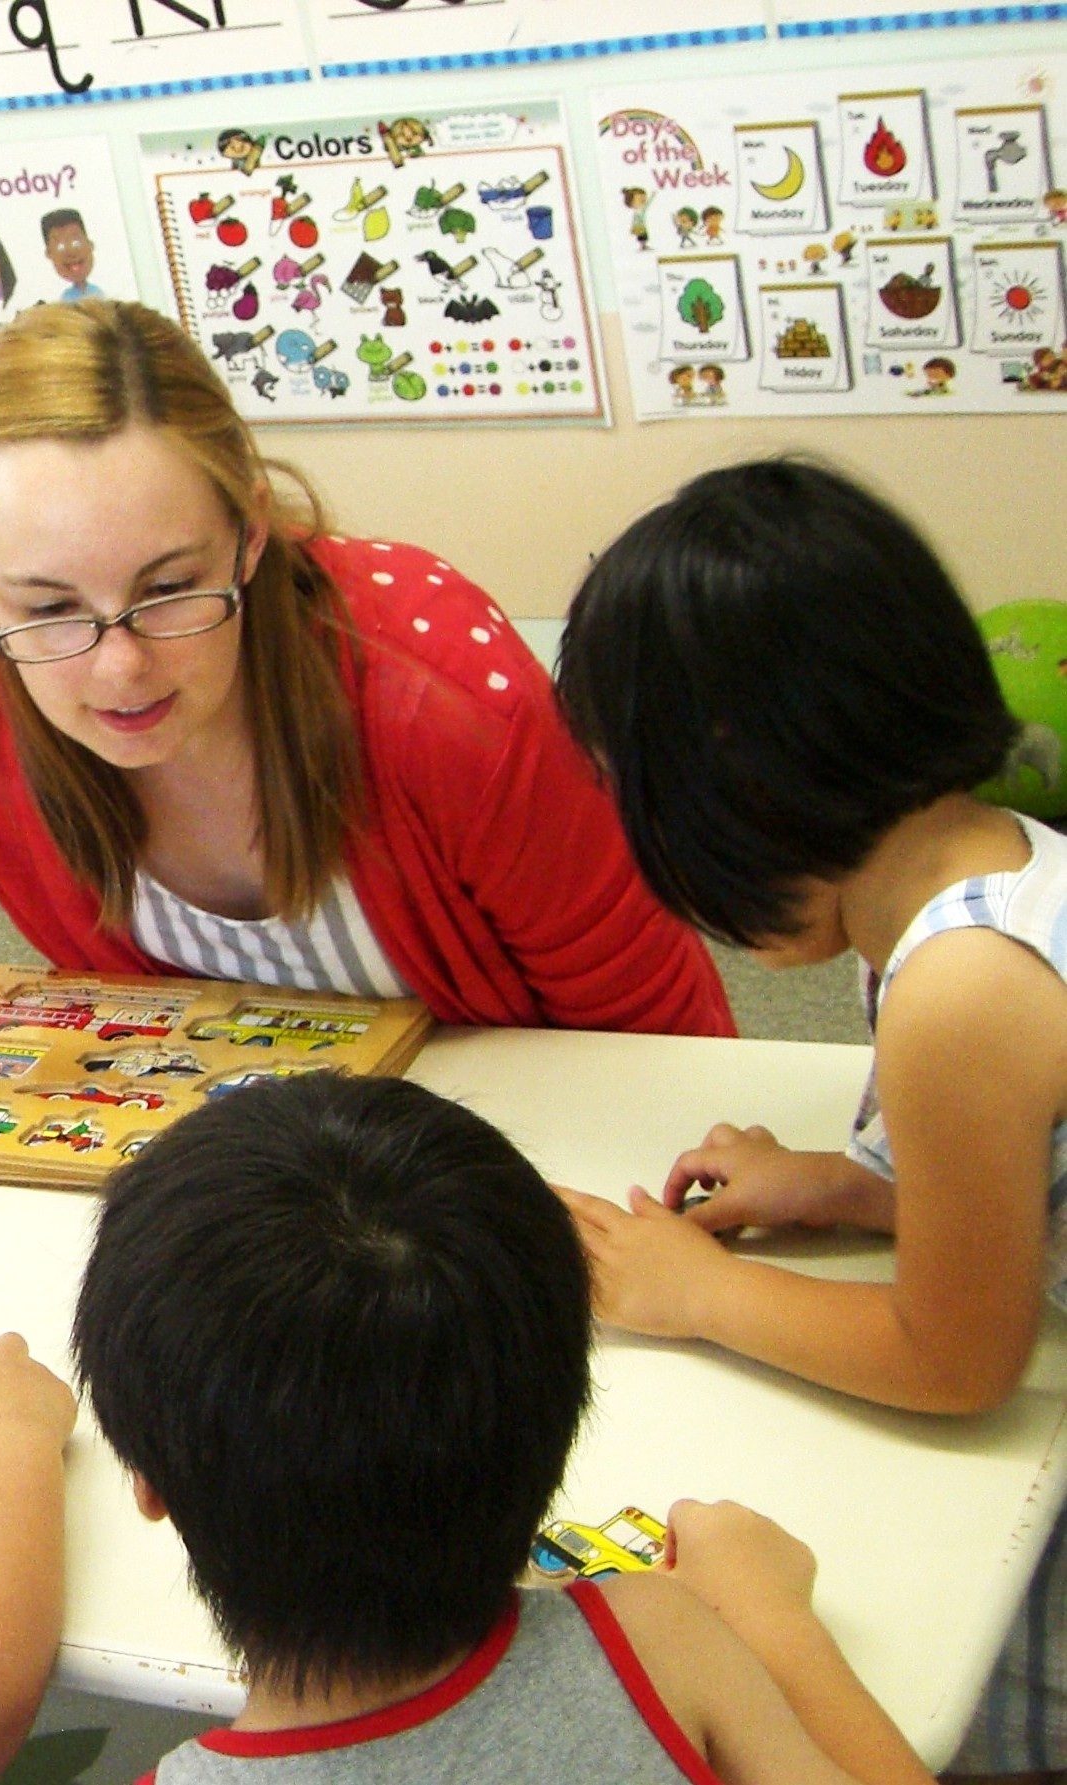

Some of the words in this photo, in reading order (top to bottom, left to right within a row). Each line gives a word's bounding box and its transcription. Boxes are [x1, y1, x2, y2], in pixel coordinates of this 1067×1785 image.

[613, 114, 678, 142] Days
[274, 132, 373, 161] Colors
[623, 140, 647, 164] of
[655, 139, 696, 162] the
[652, 162, 732, 189] Week
[854, 182, 910, 193] Tuesday
[751, 209, 806, 219] Monday
[880, 325, 939, 337] Saturday
[991, 331, 1044, 343] Sunday
[674, 340, 729, 351] Thursday
[784, 367, 822, 378] Friday
